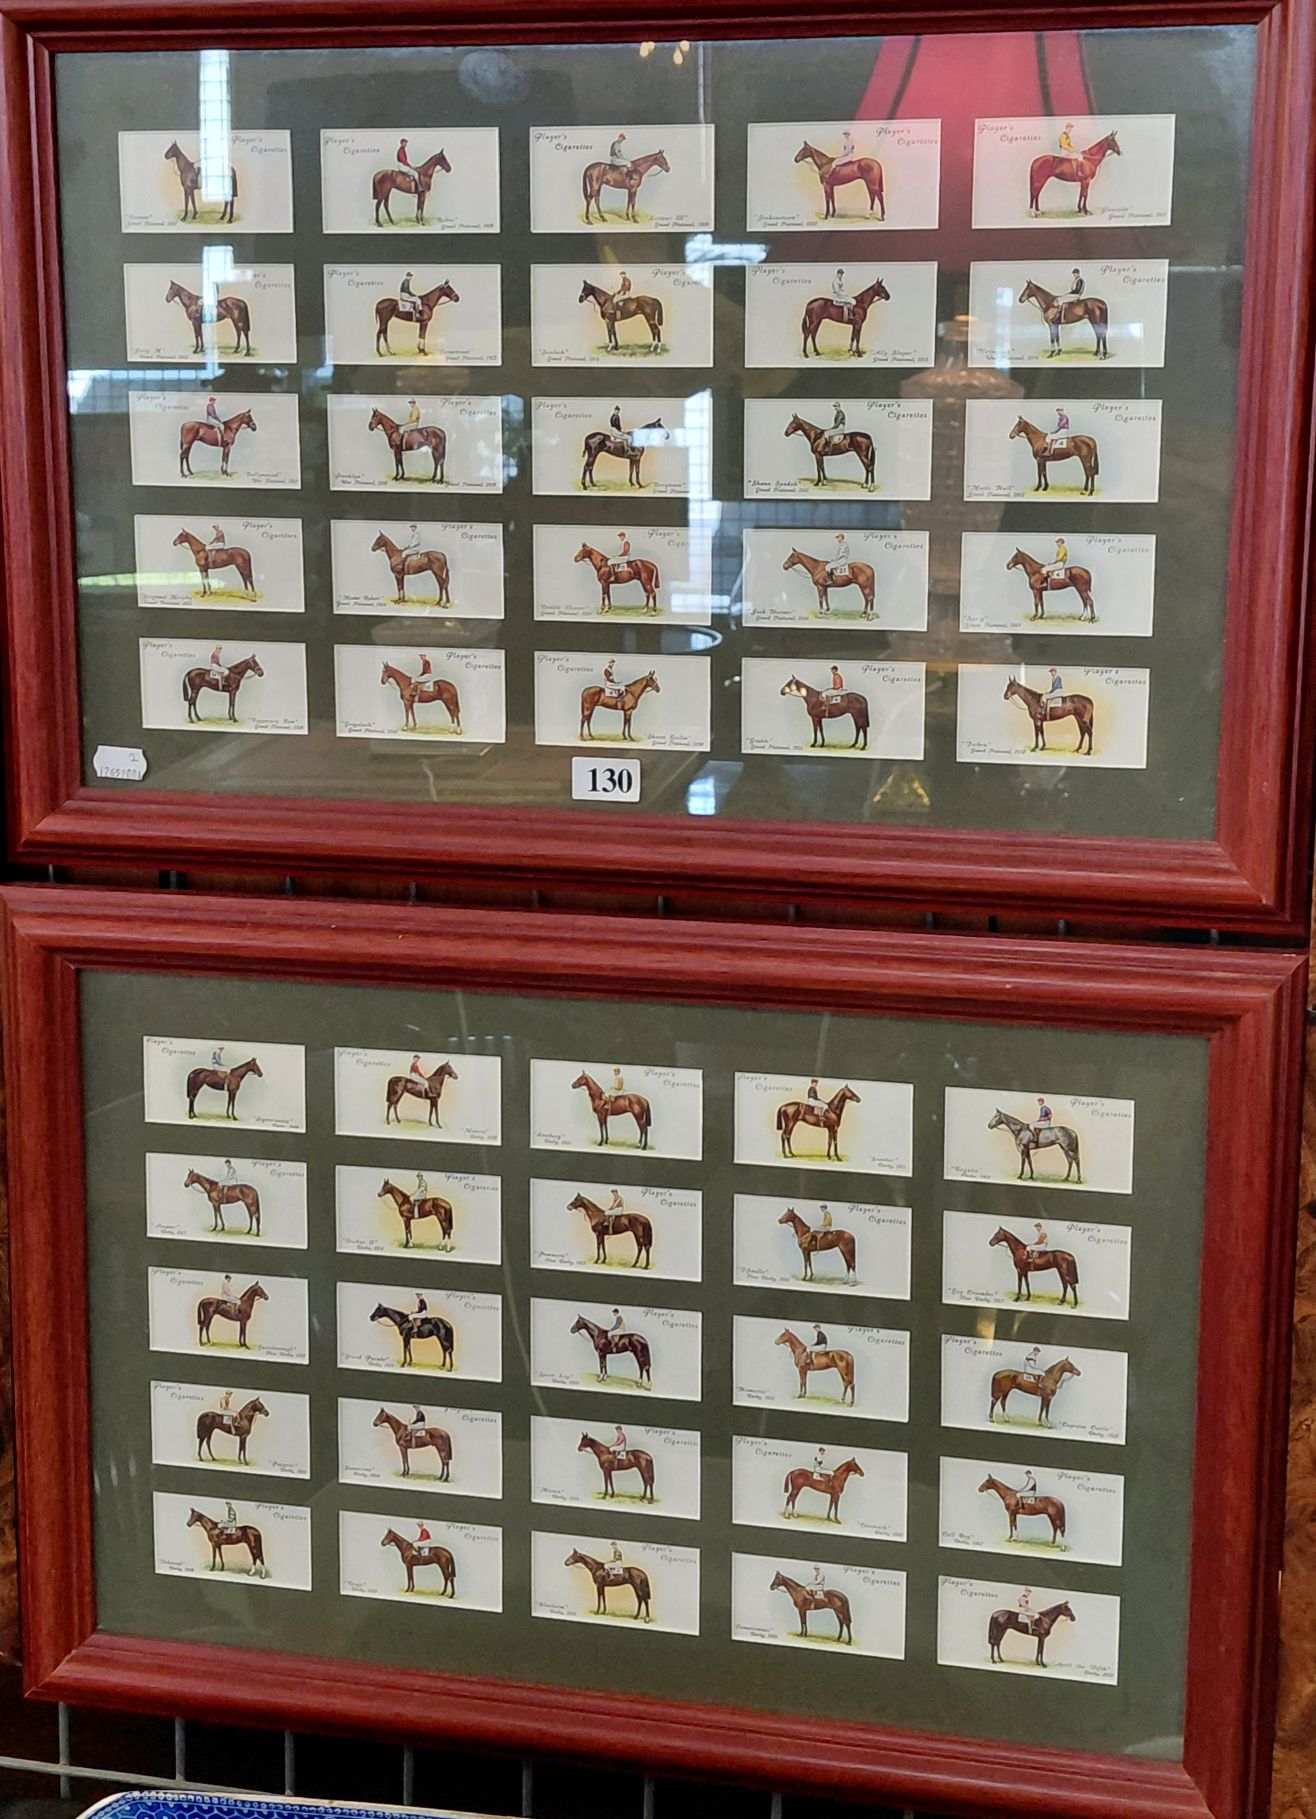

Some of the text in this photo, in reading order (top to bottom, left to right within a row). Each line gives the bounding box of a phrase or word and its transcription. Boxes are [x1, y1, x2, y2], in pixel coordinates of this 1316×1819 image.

[1000, 135, 1041, 143] Cigarettes
[555, 143, 593, 151] Cigarettes
[773, 277, 811, 285] Cigarettes
[1123, 276, 1165, 284] Cigarettes
[555, 411, 592, 419] Cigarettes
[1114, 414, 1156, 422] Cigarettes
[461, 532, 497, 540] Cigarettes
[557, 665, 593, 673] Cigarettes
[882, 675, 921, 683] Cigarettes
[1105, 677, 1146, 685] Cigarettes
[588, 768, 632, 793] 130
[162, 1047, 196, 1056] Cigarettes
[663, 1079, 700, 1088] Cigarettes
[755, 1084, 792, 1092] Cigarettes
[1091, 1110, 1131, 1118] Cigarettes
[270, 1169, 304, 1177] Cigarettes
[463, 1183, 498, 1192] Cigarettes
[660, 1199, 697, 1207] Cigarettes
[868, 1215, 906, 1224] Cigarettes
[1088, 1235, 1127, 1245] Cigarettes
[170, 1278, 203, 1286] Cigarettes
[464, 1303, 499, 1311] Cigarettes
[662, 1320, 698, 1329] Cigarettes
[868, 1336, 905, 1345] Cigarettes
[964, 1347, 1003, 1356] Cigarettes
[170, 1392, 204, 1400] Cigarettes
[462, 1414, 497, 1423] Cigarettes
[755, 1448, 791, 1457] Cigarettes
[1077, 1483, 1116, 1493] Cigarettes
[273, 1512, 307, 1520] Cigarettes
[464, 1532, 499, 1542] Cigarettes
[660, 1554, 697, 1564] Cigarettes
[863, 1576, 900, 1586] Cigarettes
[960, 1588, 998, 1599] Cigarettes
